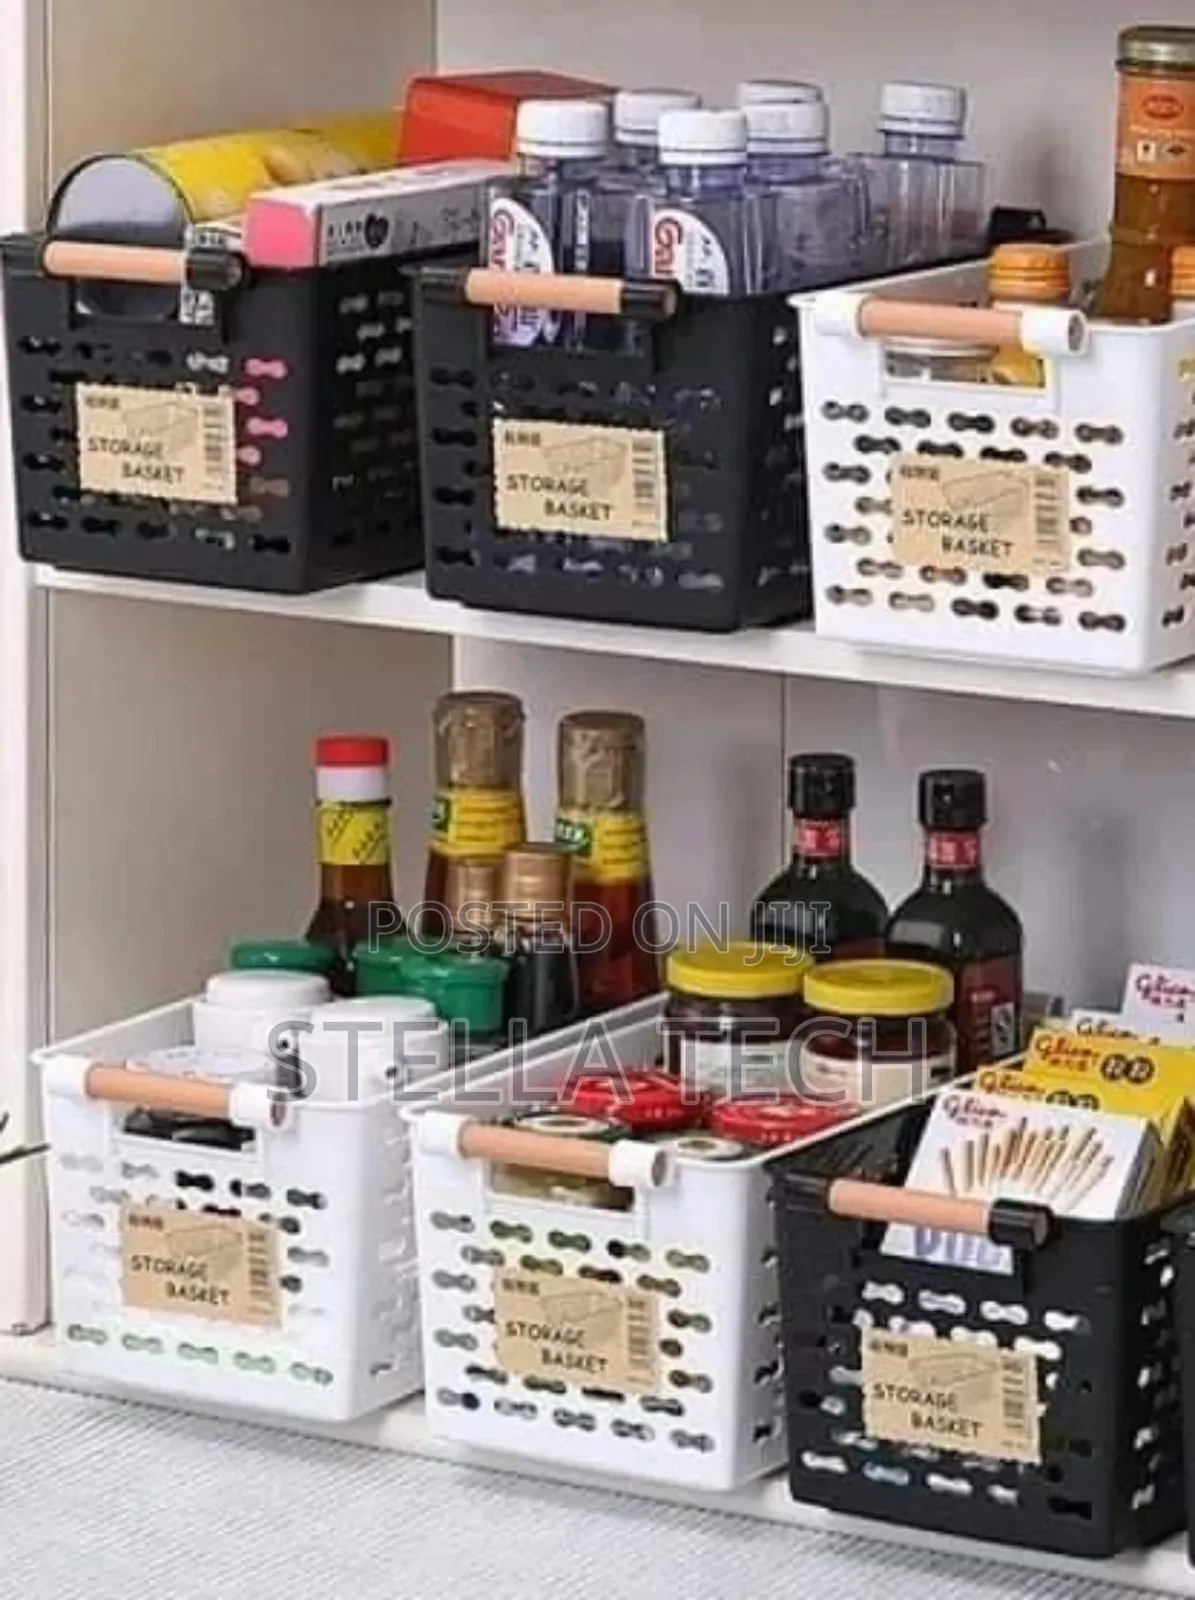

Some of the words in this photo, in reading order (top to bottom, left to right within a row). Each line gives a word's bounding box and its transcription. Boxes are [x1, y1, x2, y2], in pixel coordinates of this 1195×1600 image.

[88, 436, 164, 460] STORAGE
[121, 460, 186, 484] BASKET
[505, 472, 590, 498] STORAGE
[544, 498, 614, 521] BASKET
[901, 508, 989, 533] STORAGE
[941, 534, 1015, 558] BASKET
[130, 1254, 209, 1282] STORAGE
[165, 1281, 231, 1306] BASKET
[505, 1320, 586, 1348] STORAGE
[541, 1348, 609, 1374] BASKET
[872, 1382, 958, 1411] STORAGE
[910, 1411, 982, 1438] BASKET
